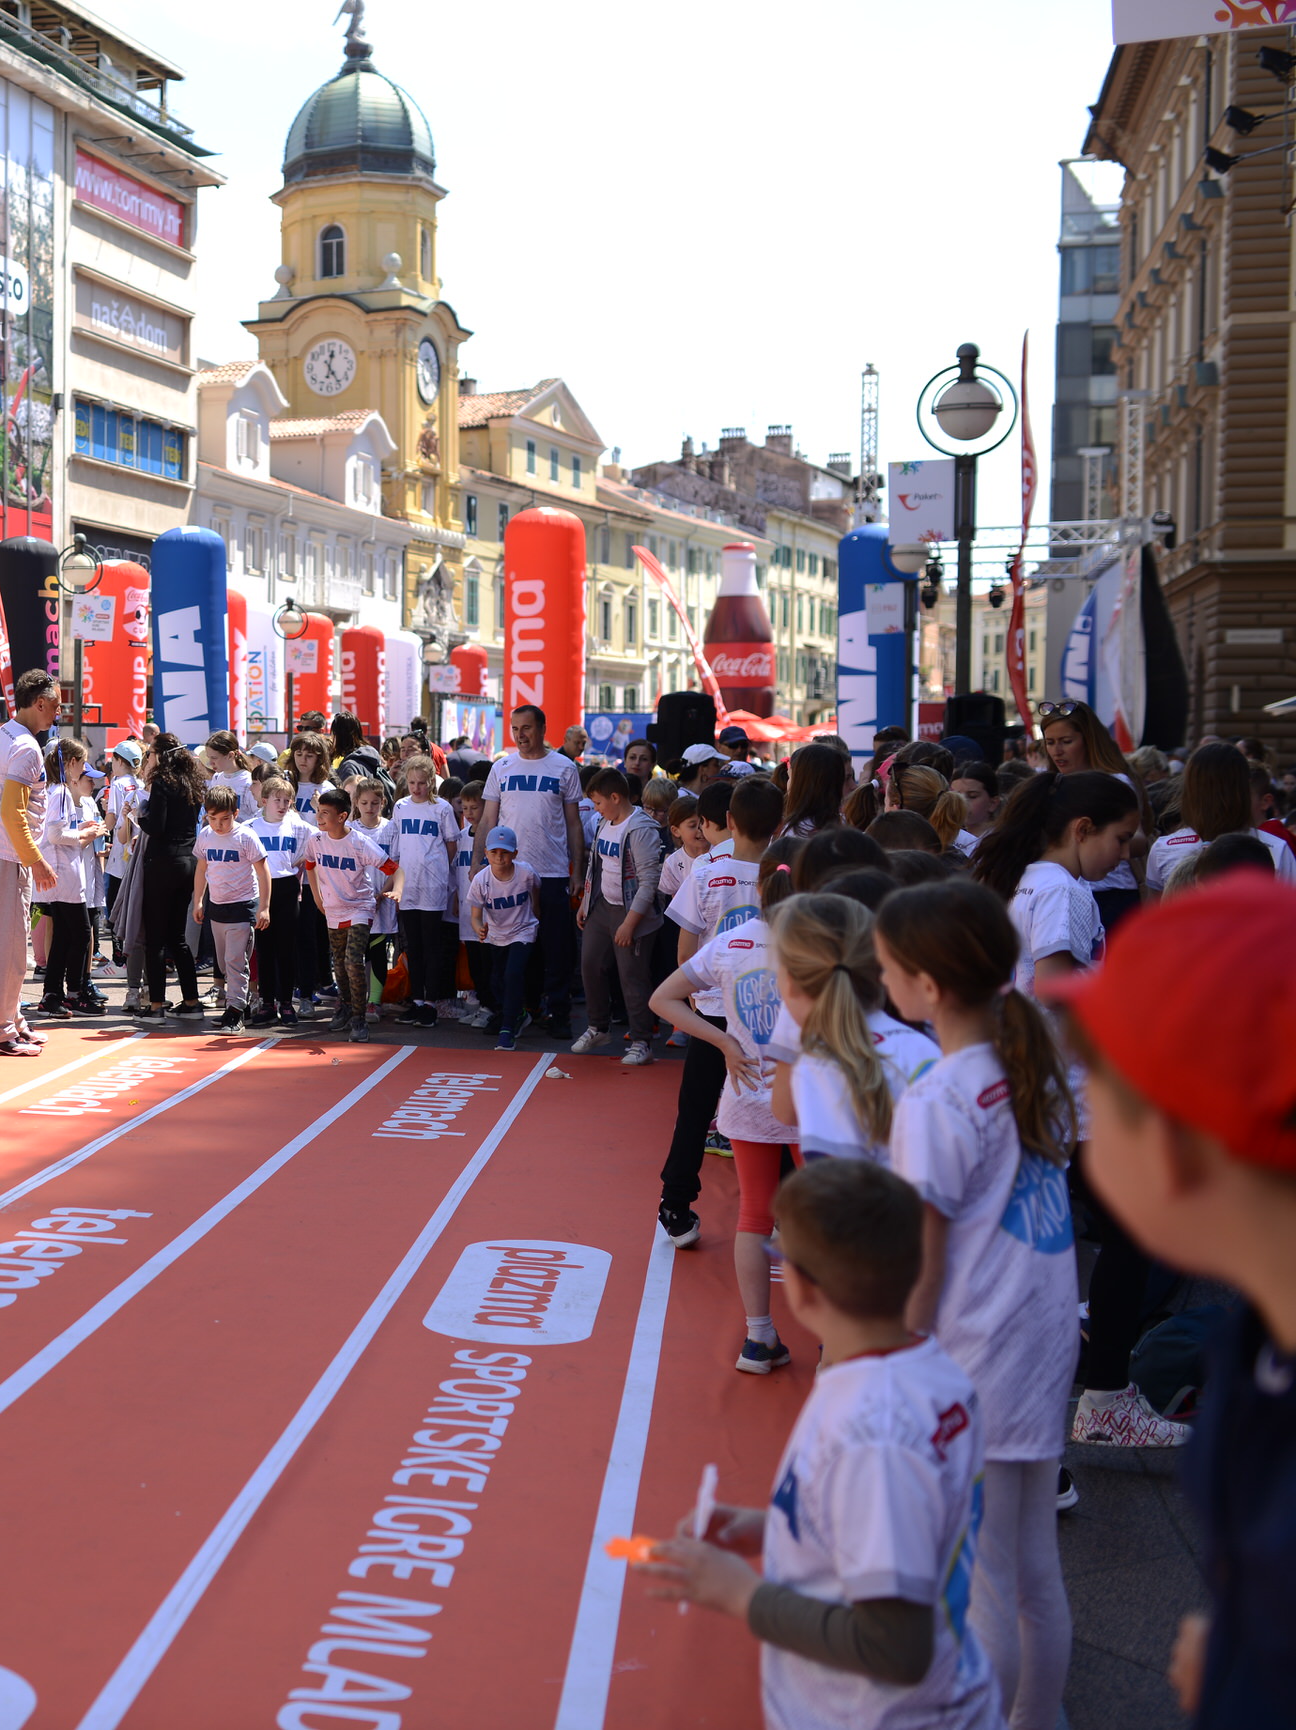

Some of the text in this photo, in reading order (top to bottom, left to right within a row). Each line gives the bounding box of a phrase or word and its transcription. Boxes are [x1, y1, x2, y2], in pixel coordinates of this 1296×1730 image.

[75, 166, 182, 236] www.tommy.hr
[91, 301, 168, 353] naš dom
[132, 655, 147, 713] CUP
[709, 652, 771, 678] Coca-Cola
[18, 1056, 197, 1116] telemach
[371, 1072, 502, 1140] telemach
[472, 1245, 585, 1330] plazma
[392, 1349, 533, 1493] SPORTSKE
[347, 1495, 479, 1589] IGRE
